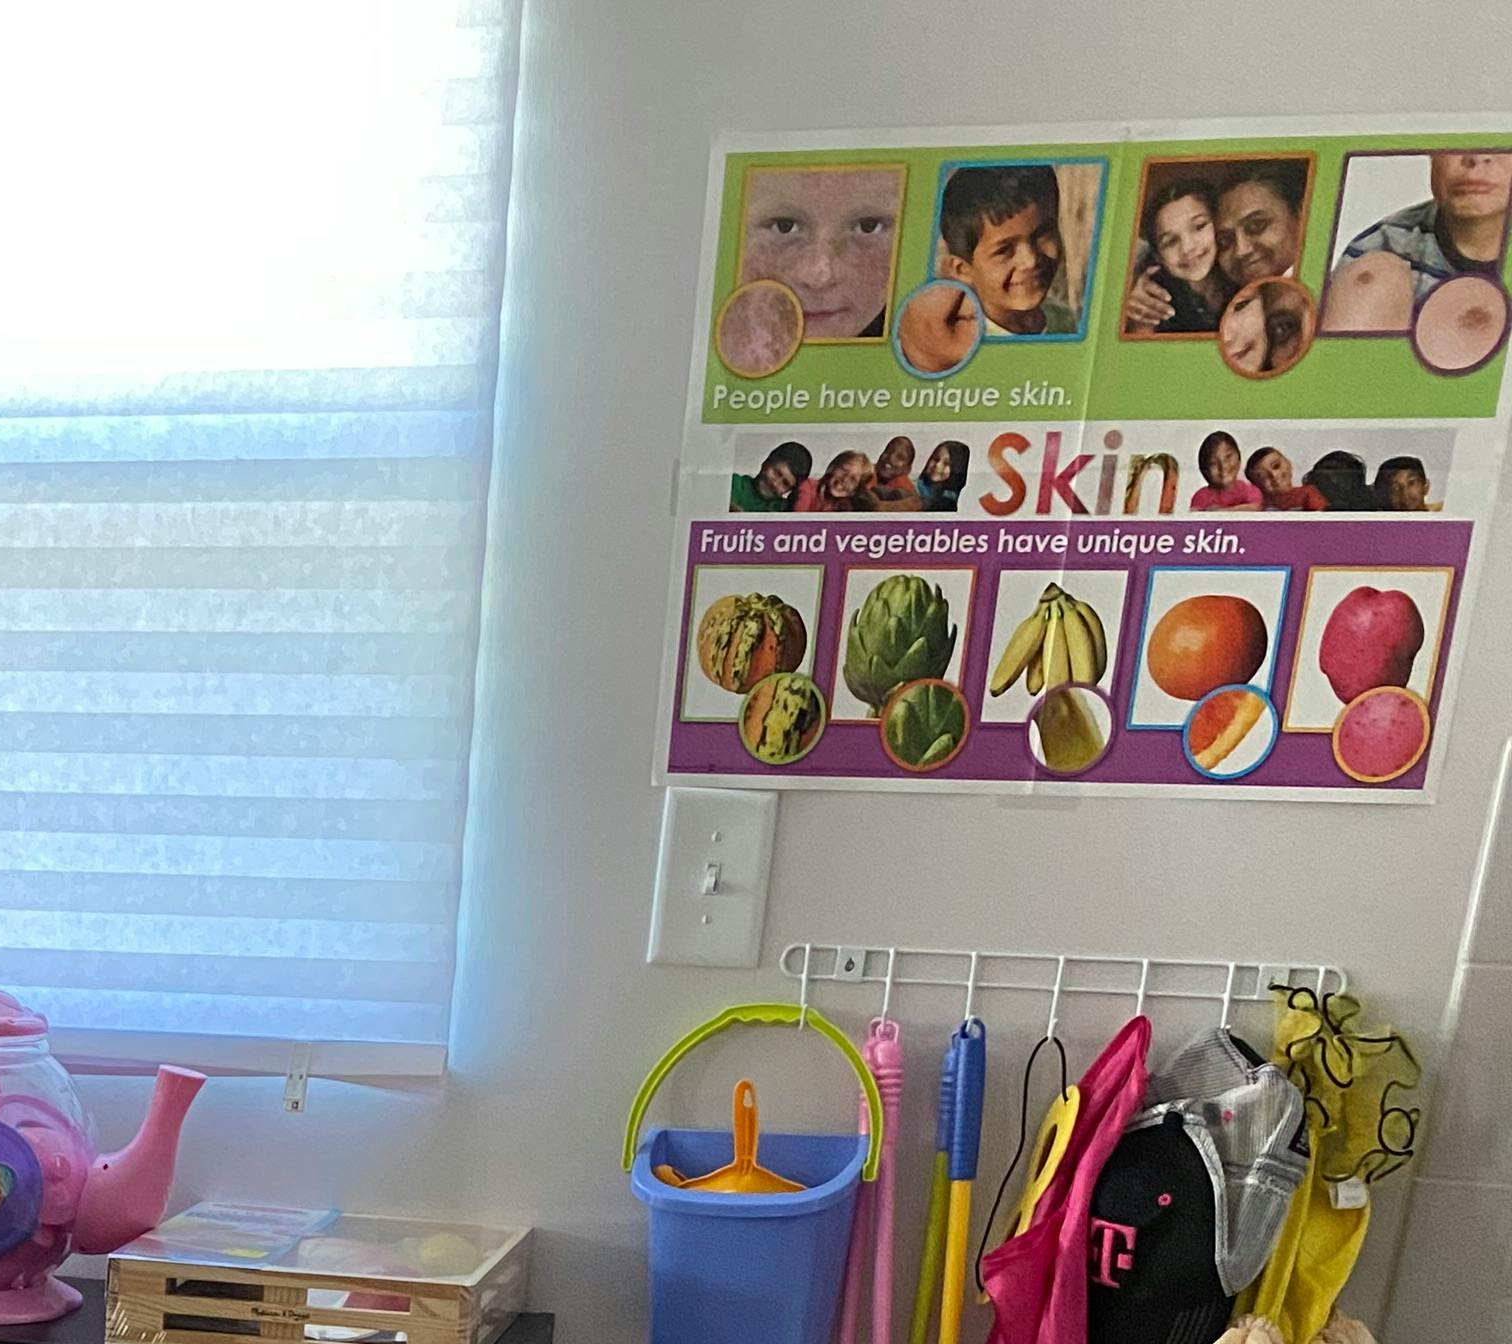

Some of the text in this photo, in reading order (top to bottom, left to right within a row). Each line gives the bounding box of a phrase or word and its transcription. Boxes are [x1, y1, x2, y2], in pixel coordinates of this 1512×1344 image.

[713, 380, 1073, 415] People have unique skin.
[978, 429, 1180, 517] Skin
[701, 528, 1246, 559] Fruits and vegetables have unique skin.
[1091, 1217, 1138, 1289] T
